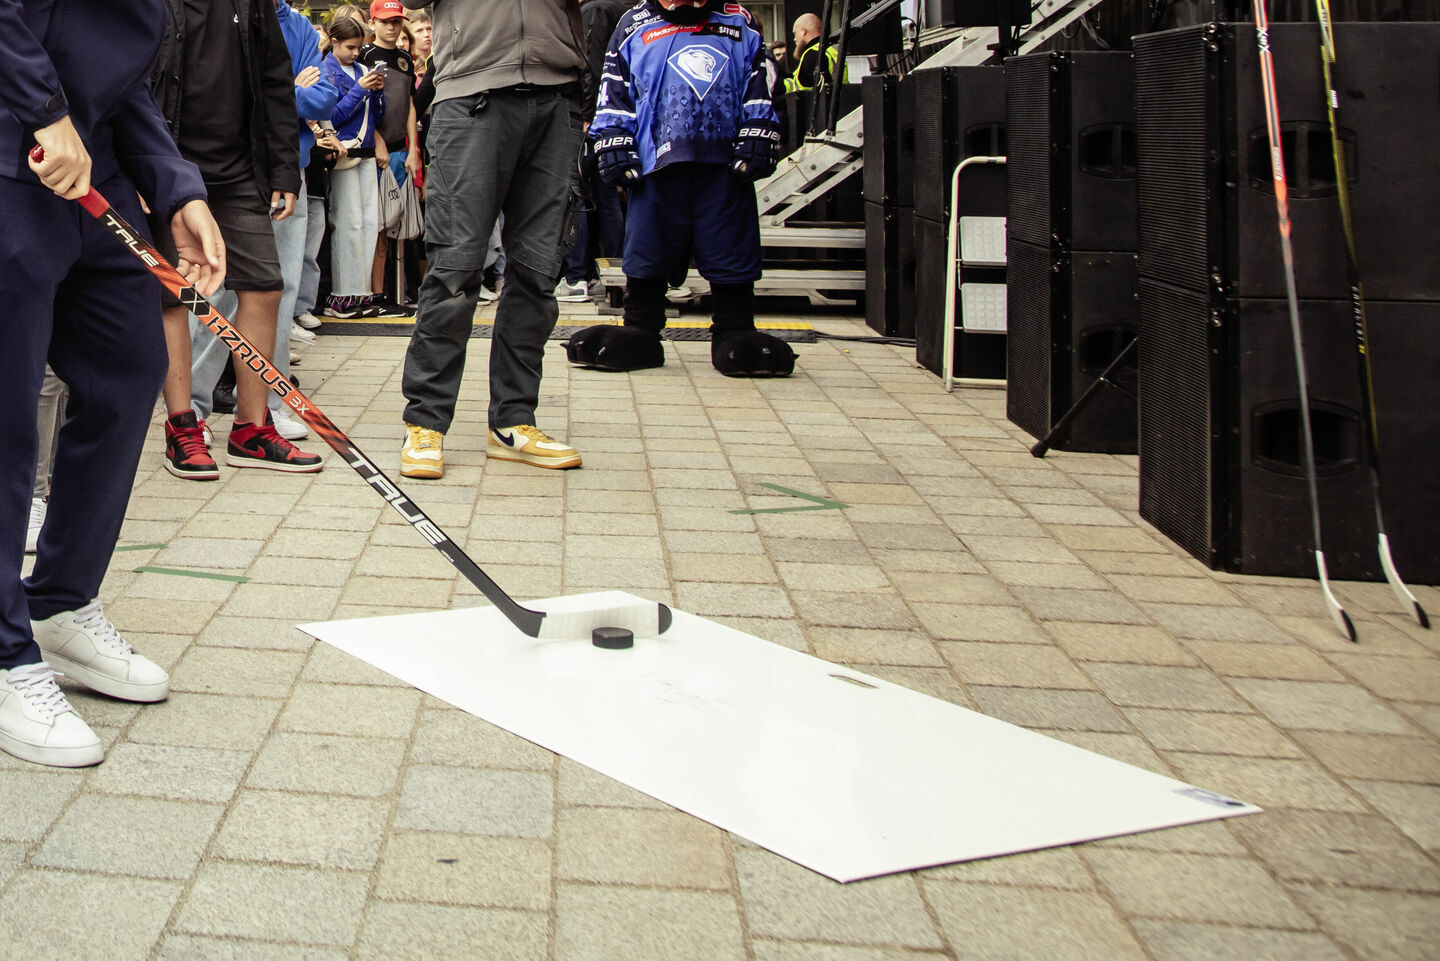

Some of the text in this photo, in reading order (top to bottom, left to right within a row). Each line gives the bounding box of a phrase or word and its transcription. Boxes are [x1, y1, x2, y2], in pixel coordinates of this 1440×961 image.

[106, 214, 159, 268] TRUE
[206, 315, 310, 416] HZRDUS 3X
[348, 447, 448, 546] TRUE
